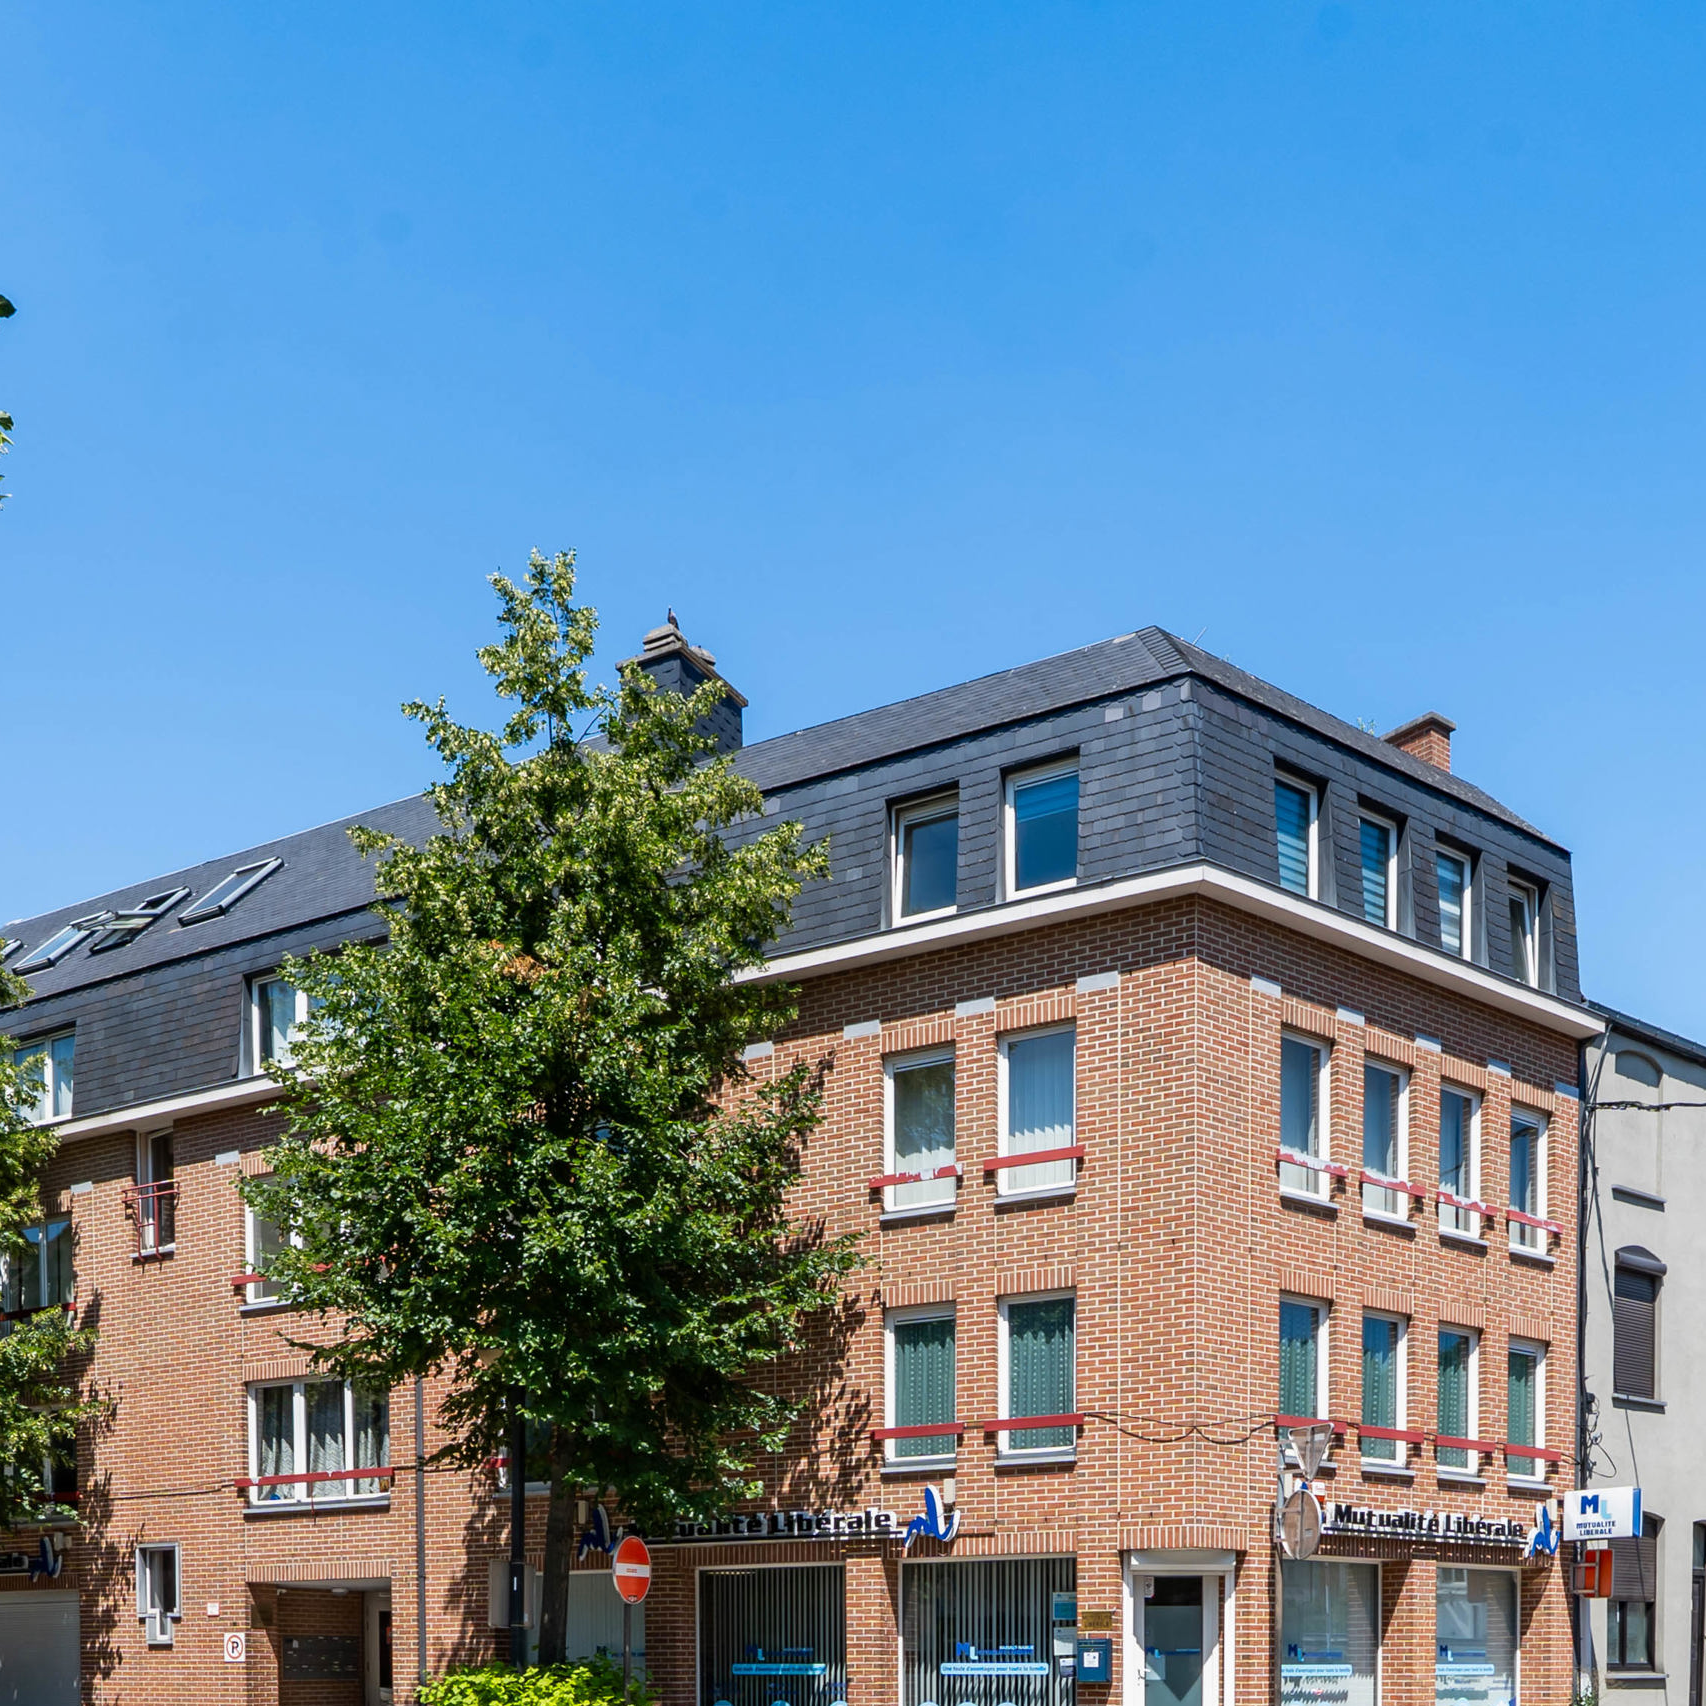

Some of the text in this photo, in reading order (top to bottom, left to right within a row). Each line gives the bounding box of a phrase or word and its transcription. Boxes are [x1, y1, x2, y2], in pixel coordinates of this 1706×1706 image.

[1580, 1494, 1612, 1520] ML
[770, 1508, 892, 1534] Libérale
[1334, 1503, 1440, 1533] Mutualité
[1445, 1513, 1524, 1538] Libérale
[1576, 1520, 1616, 1530] MUTUALITE
[1579, 1528, 1613, 1536] LIBERALE
